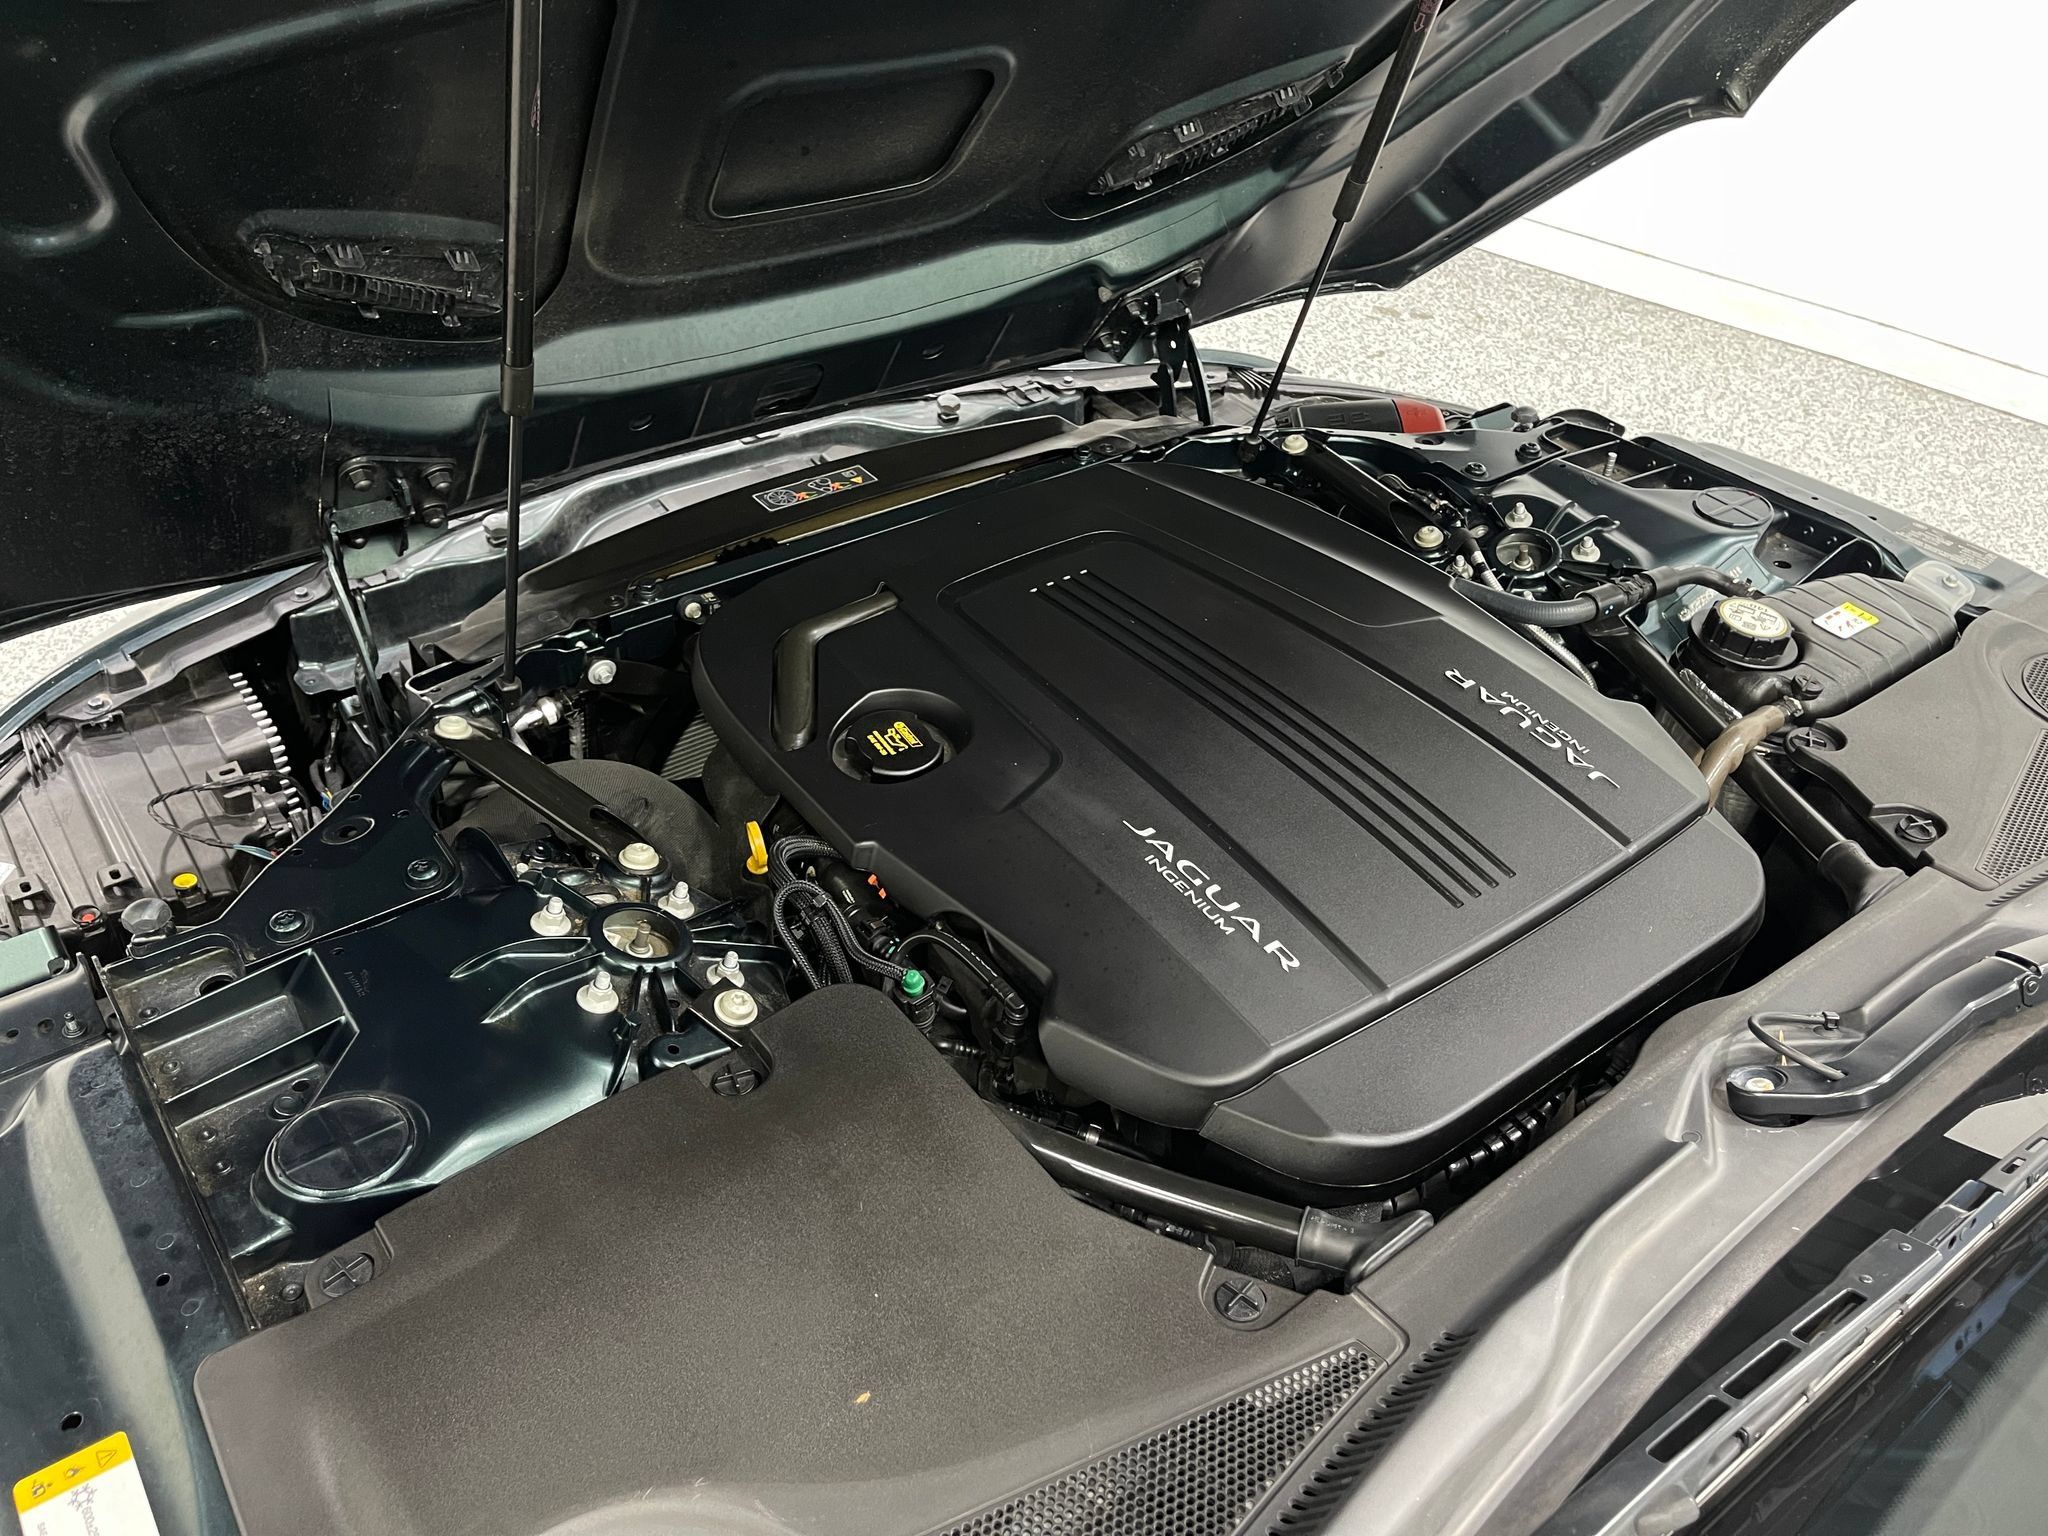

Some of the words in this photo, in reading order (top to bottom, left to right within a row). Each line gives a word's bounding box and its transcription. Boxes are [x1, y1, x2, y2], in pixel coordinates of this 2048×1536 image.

[1444, 668, 1620, 788] JAGUAR
[1500, 691, 1590, 754] INGENIUM
[1122, 820, 1300, 972] JAGUAR
[1144, 855, 1235, 935] INGENIUM
